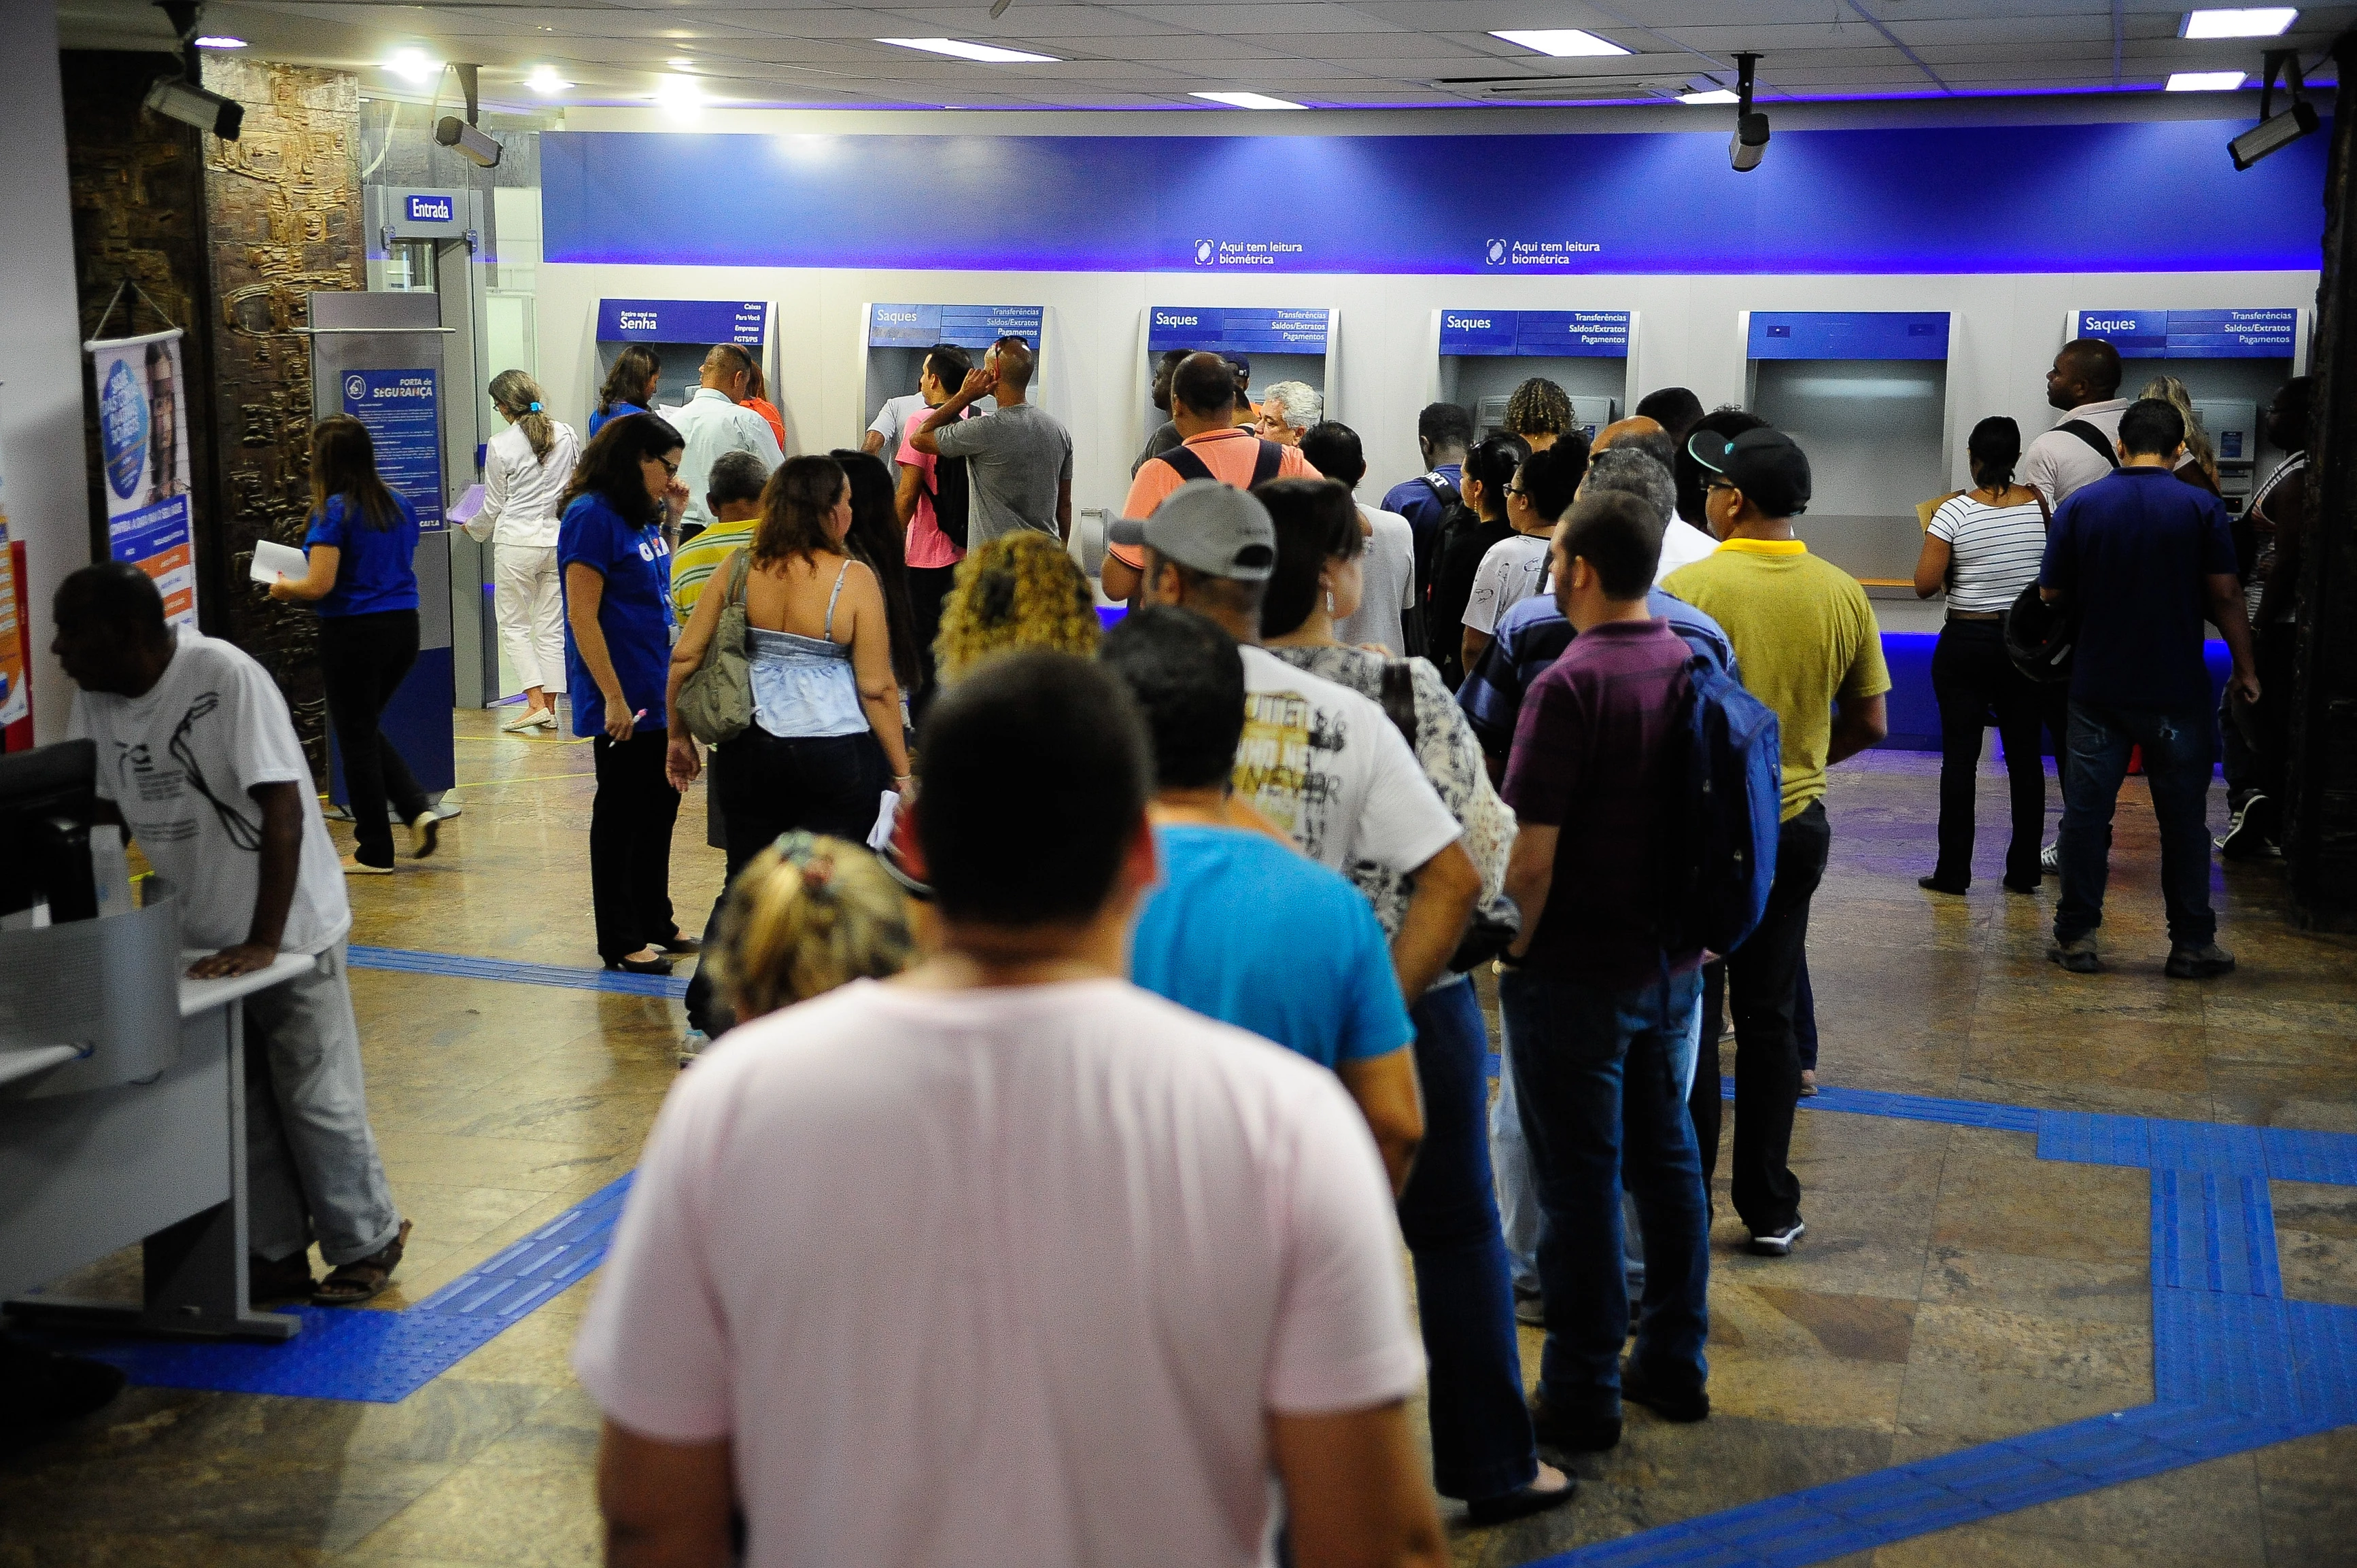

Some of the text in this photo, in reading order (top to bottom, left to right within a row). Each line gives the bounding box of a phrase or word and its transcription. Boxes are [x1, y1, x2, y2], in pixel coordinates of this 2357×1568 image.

[413, 198, 449, 219] Entrada
[1220, 242, 1303, 255] Aqui tem leitura
[1512, 241, 1600, 255] Aqui tem leitura
[1220, 254, 1274, 264] biométrica
[1512, 254, 1570, 264] biométrica
[877, 309, 917, 326] Saques
[1277, 311, 1326, 319] Transferências
[1575, 313, 1626, 321] Transferências
[2231, 311, 2292, 319] Transferências
[620, 317, 657, 330] Senha
[1156, 313, 1198, 328] Saques
[1447, 315, 1491, 331] Saques
[2086, 317, 2135, 333] Saques
[1272, 322, 1325, 330] Saldos/Extratos
[1569, 325, 1625, 333] Saldos/Extratos
[2224, 324, 2290, 332] Saldos/Extratos
[998, 328, 1037, 336] Pagamentos
[1283, 333, 1324, 341] Pagamentos
[1581, 336, 1625, 344] Pagamentos
[2239, 335, 2290, 345] Pagamentos
[373, 387, 432, 399] SEGURANÇA
